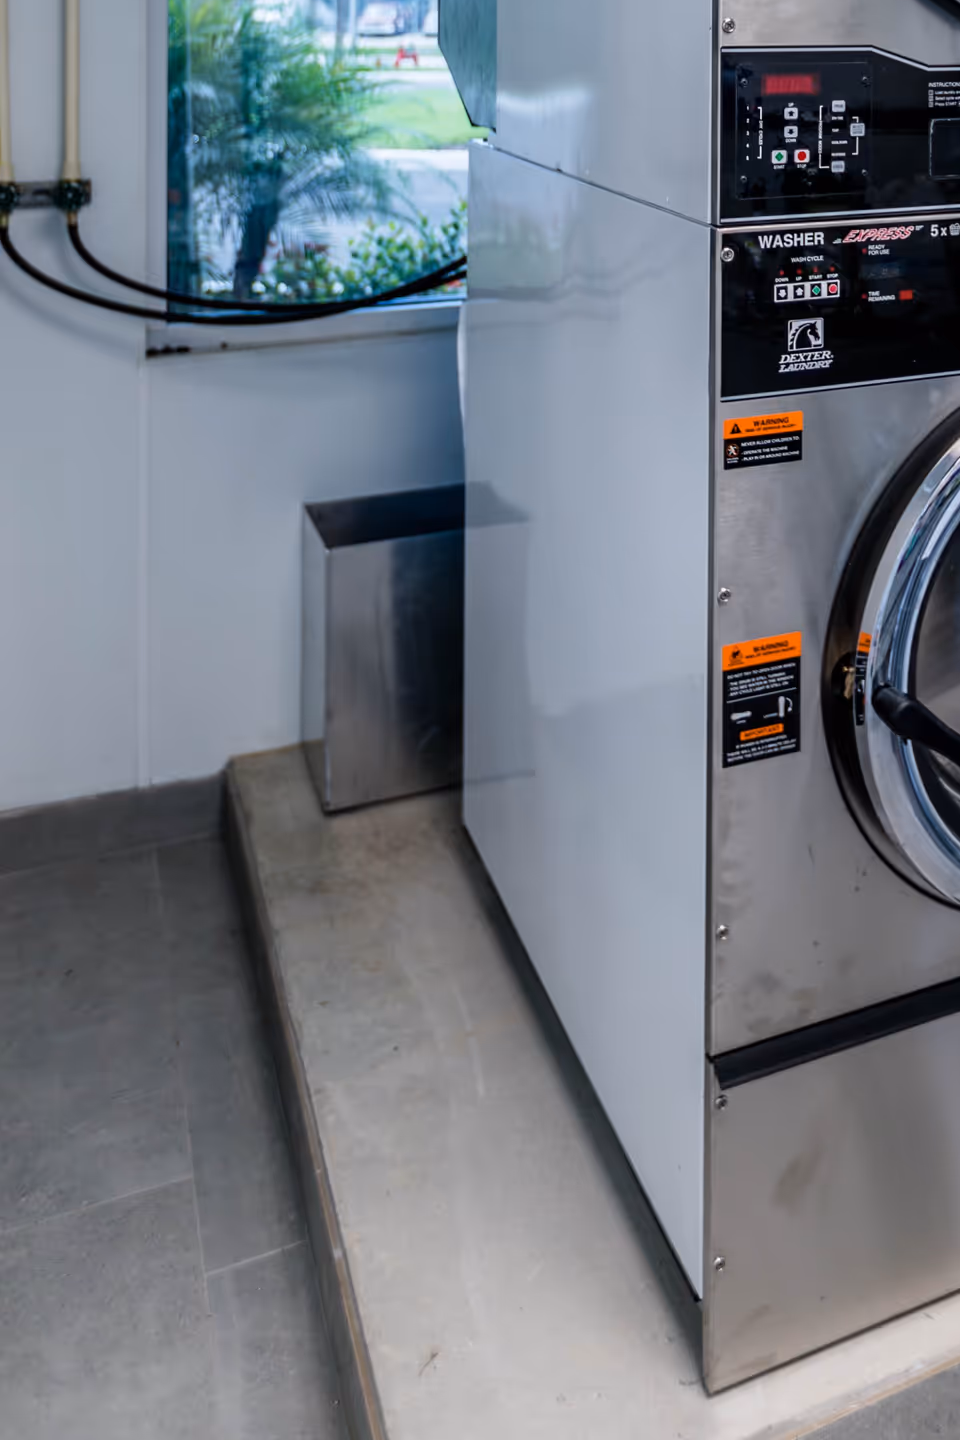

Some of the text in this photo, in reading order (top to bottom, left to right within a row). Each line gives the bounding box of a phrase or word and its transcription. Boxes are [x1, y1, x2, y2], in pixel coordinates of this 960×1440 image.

[758, 232, 825, 249] WASHER
[842, 226, 914, 244] EXPRESS
[807, 254, 824, 262] CYCLE
[778, 350, 831, 364] DEXTER
[778, 360, 833, 373] LAUNDRY
[753, 417, 789, 427] WARNING
